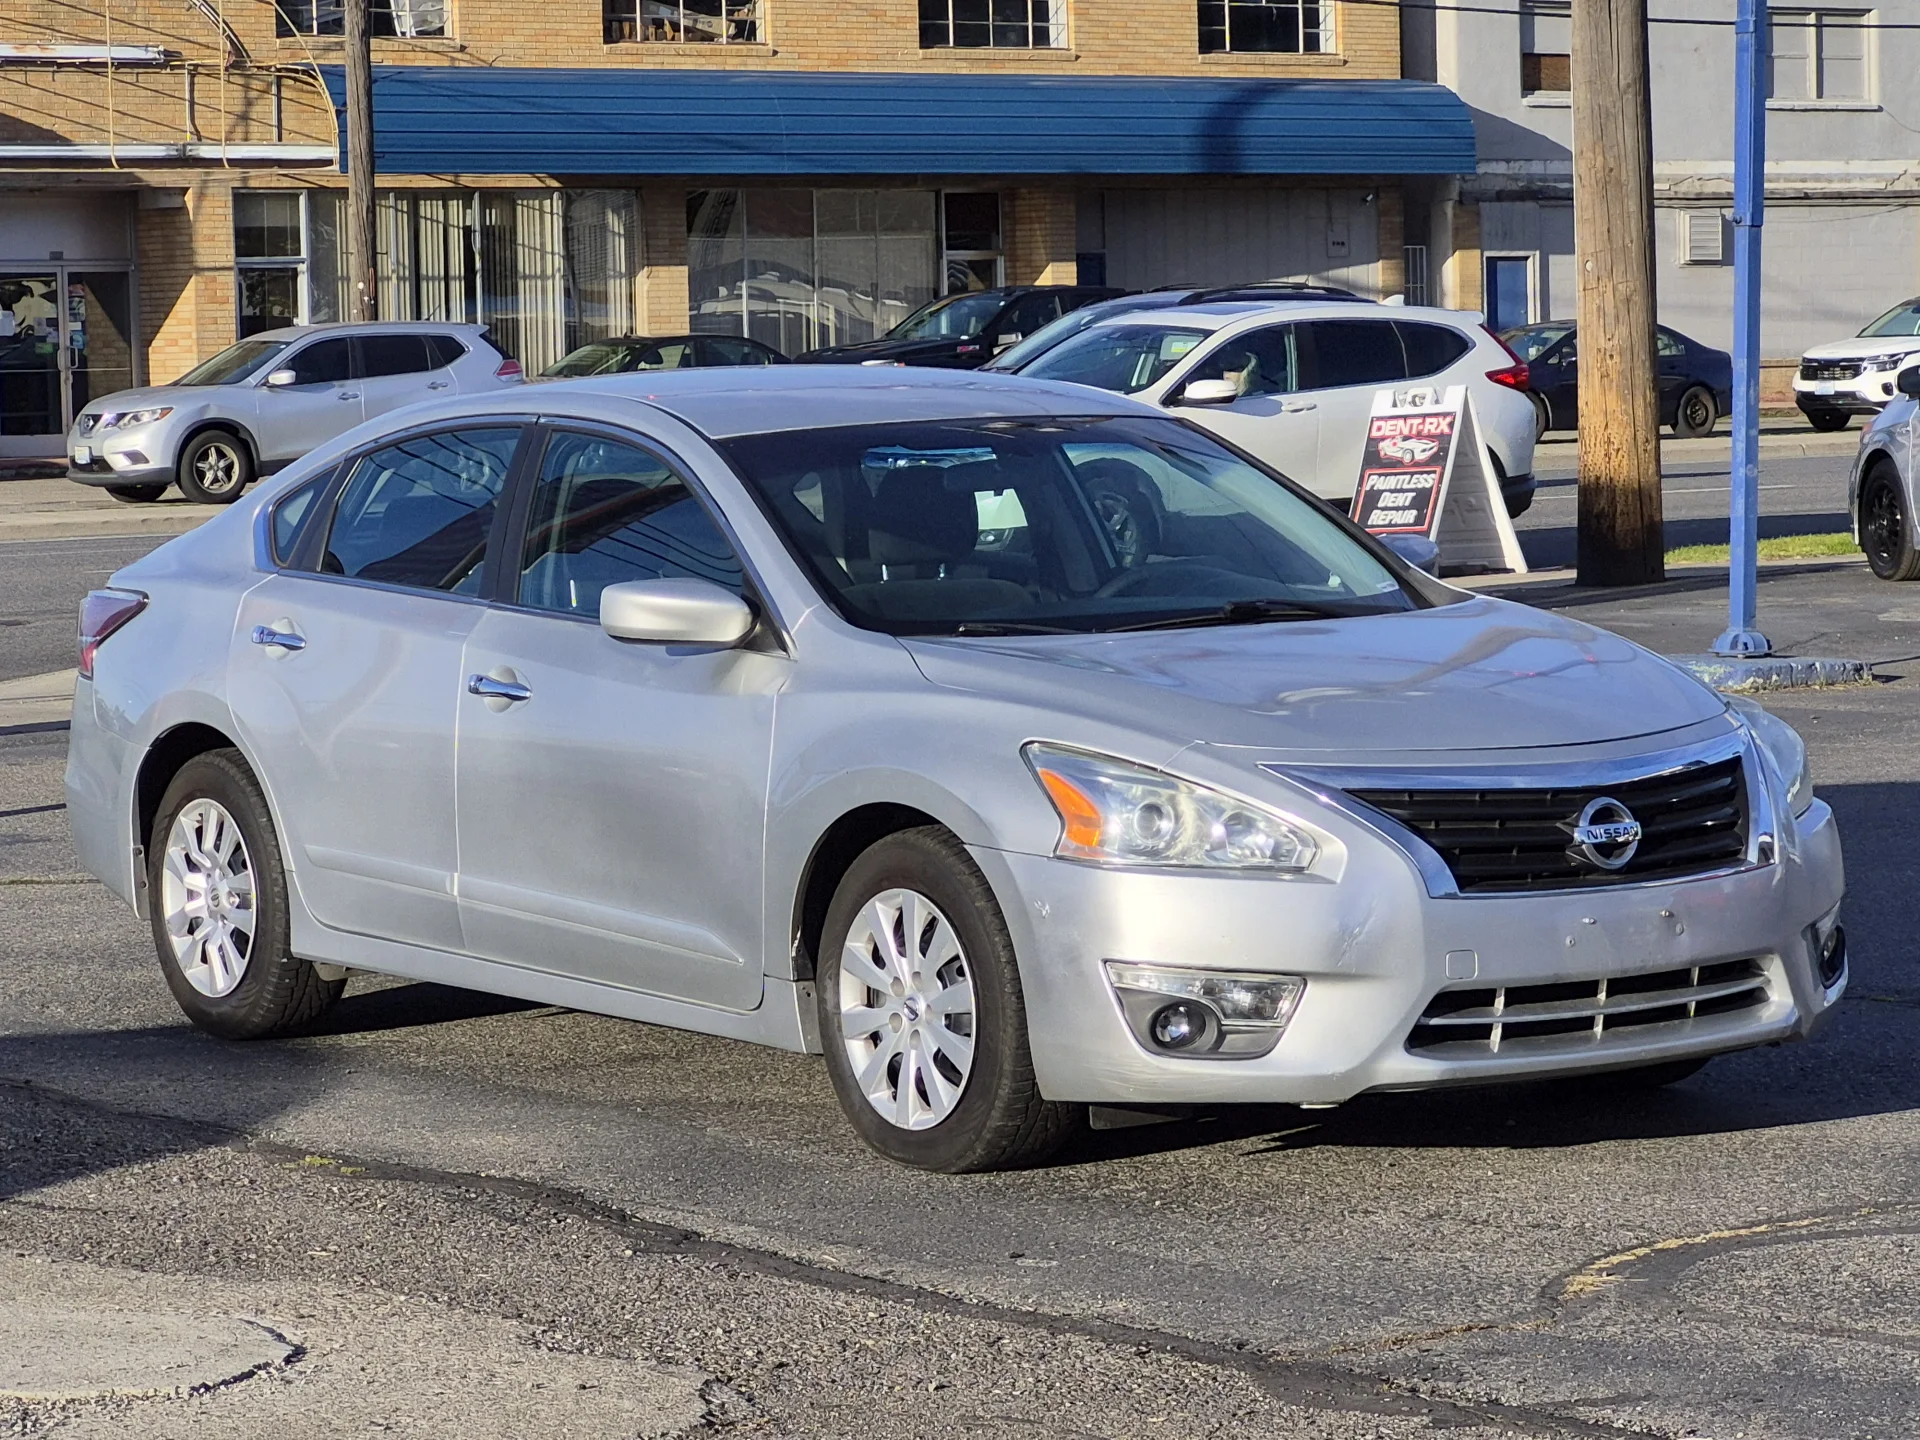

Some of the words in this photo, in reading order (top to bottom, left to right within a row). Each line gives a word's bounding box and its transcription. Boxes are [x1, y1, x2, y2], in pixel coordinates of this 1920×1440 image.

[1366, 474, 1435, 490] PAINTLESS
[1378, 492, 1416, 507] DENT
[1368, 510, 1418, 525] REPAIR
